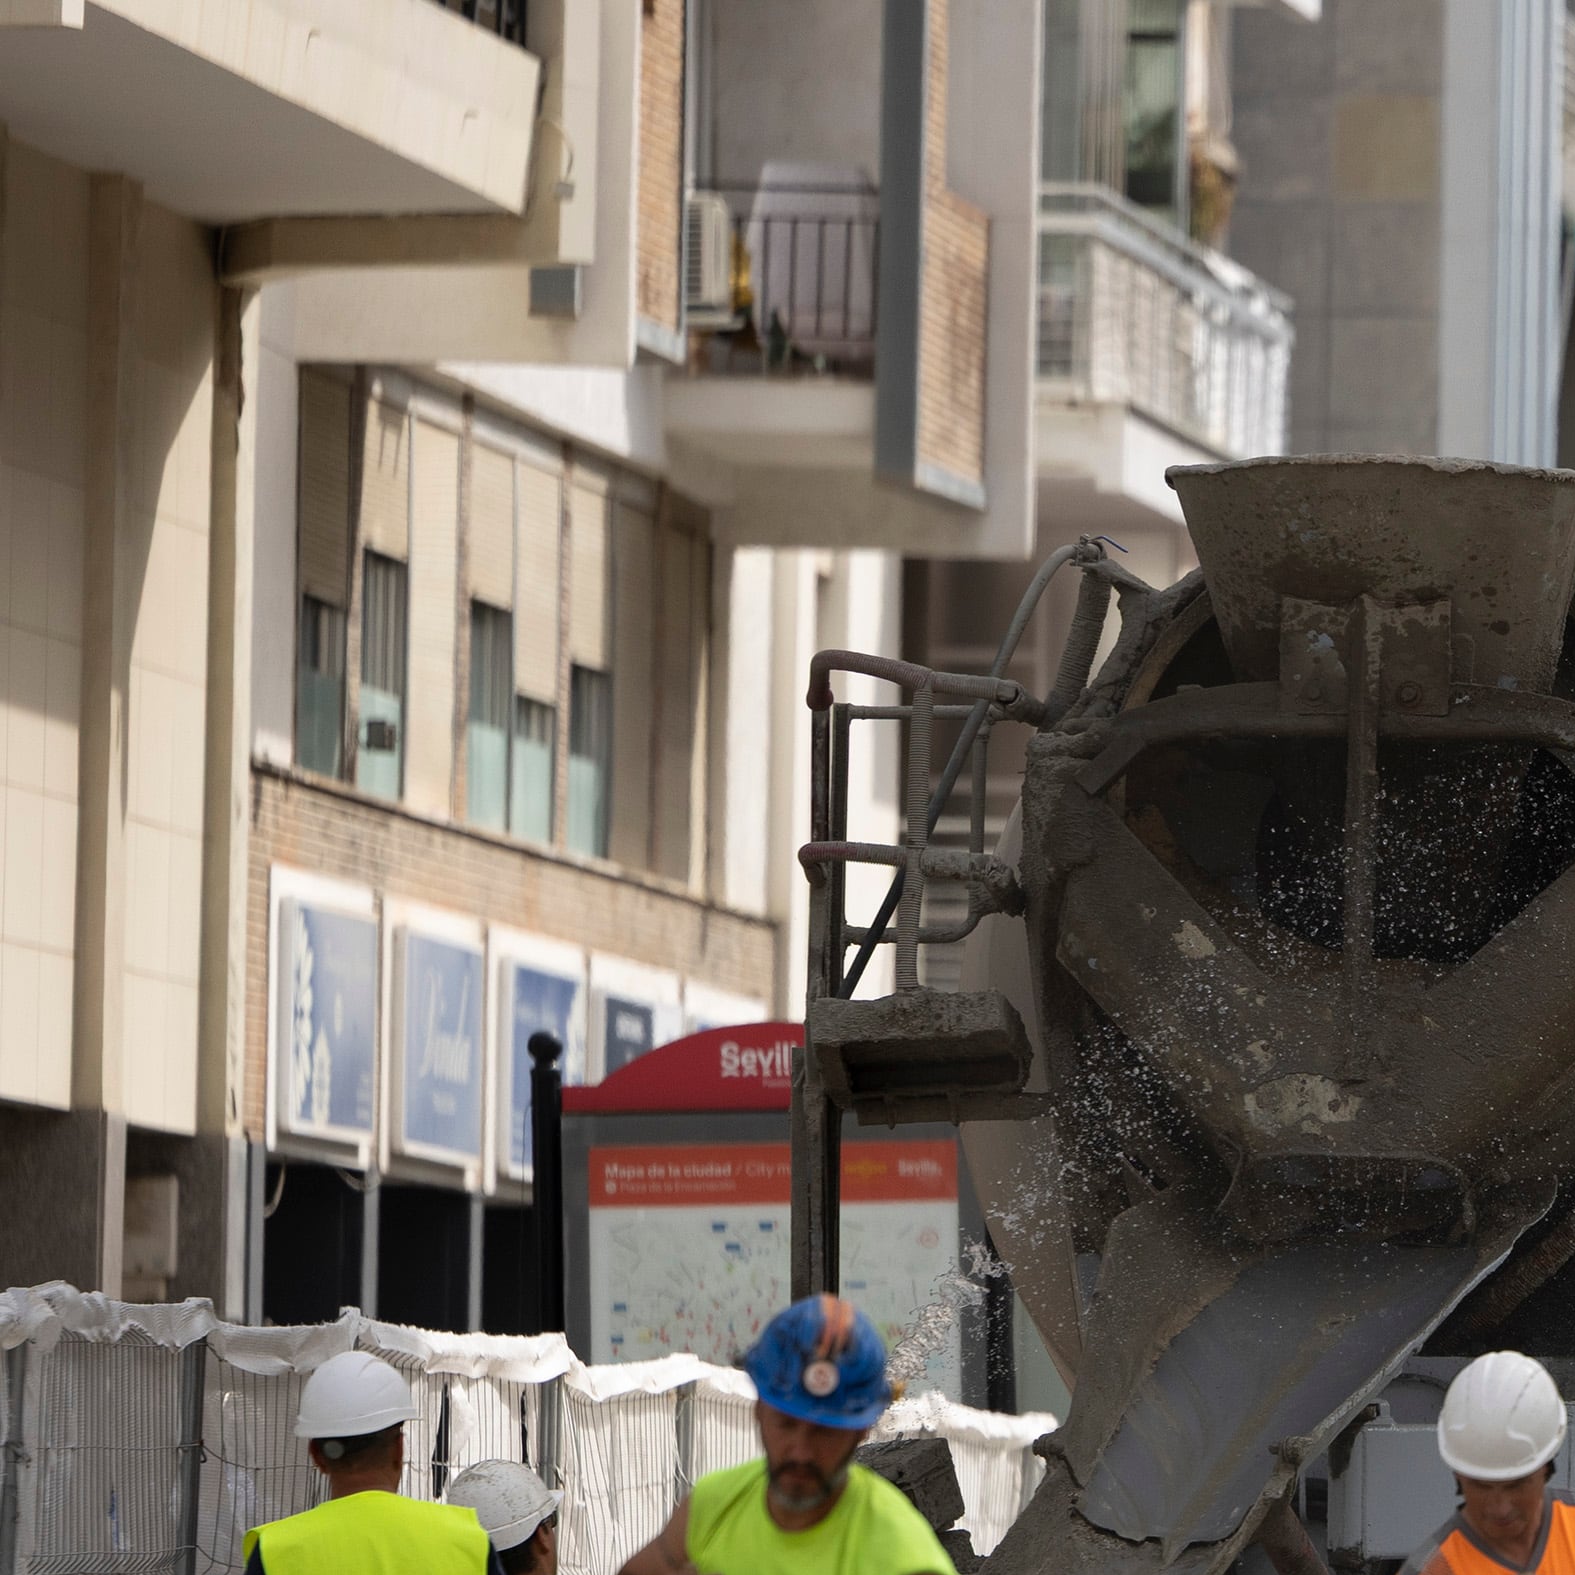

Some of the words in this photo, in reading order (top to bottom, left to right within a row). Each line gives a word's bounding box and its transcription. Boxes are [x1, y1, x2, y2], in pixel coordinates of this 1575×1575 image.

[720, 1040, 798, 1077] Sevil
[605, 1163, 645, 1180] Mapa
[648, 1162, 666, 1178] de
[668, 1162, 681, 1178] la
[683, 1161, 732, 1178] ciudad
